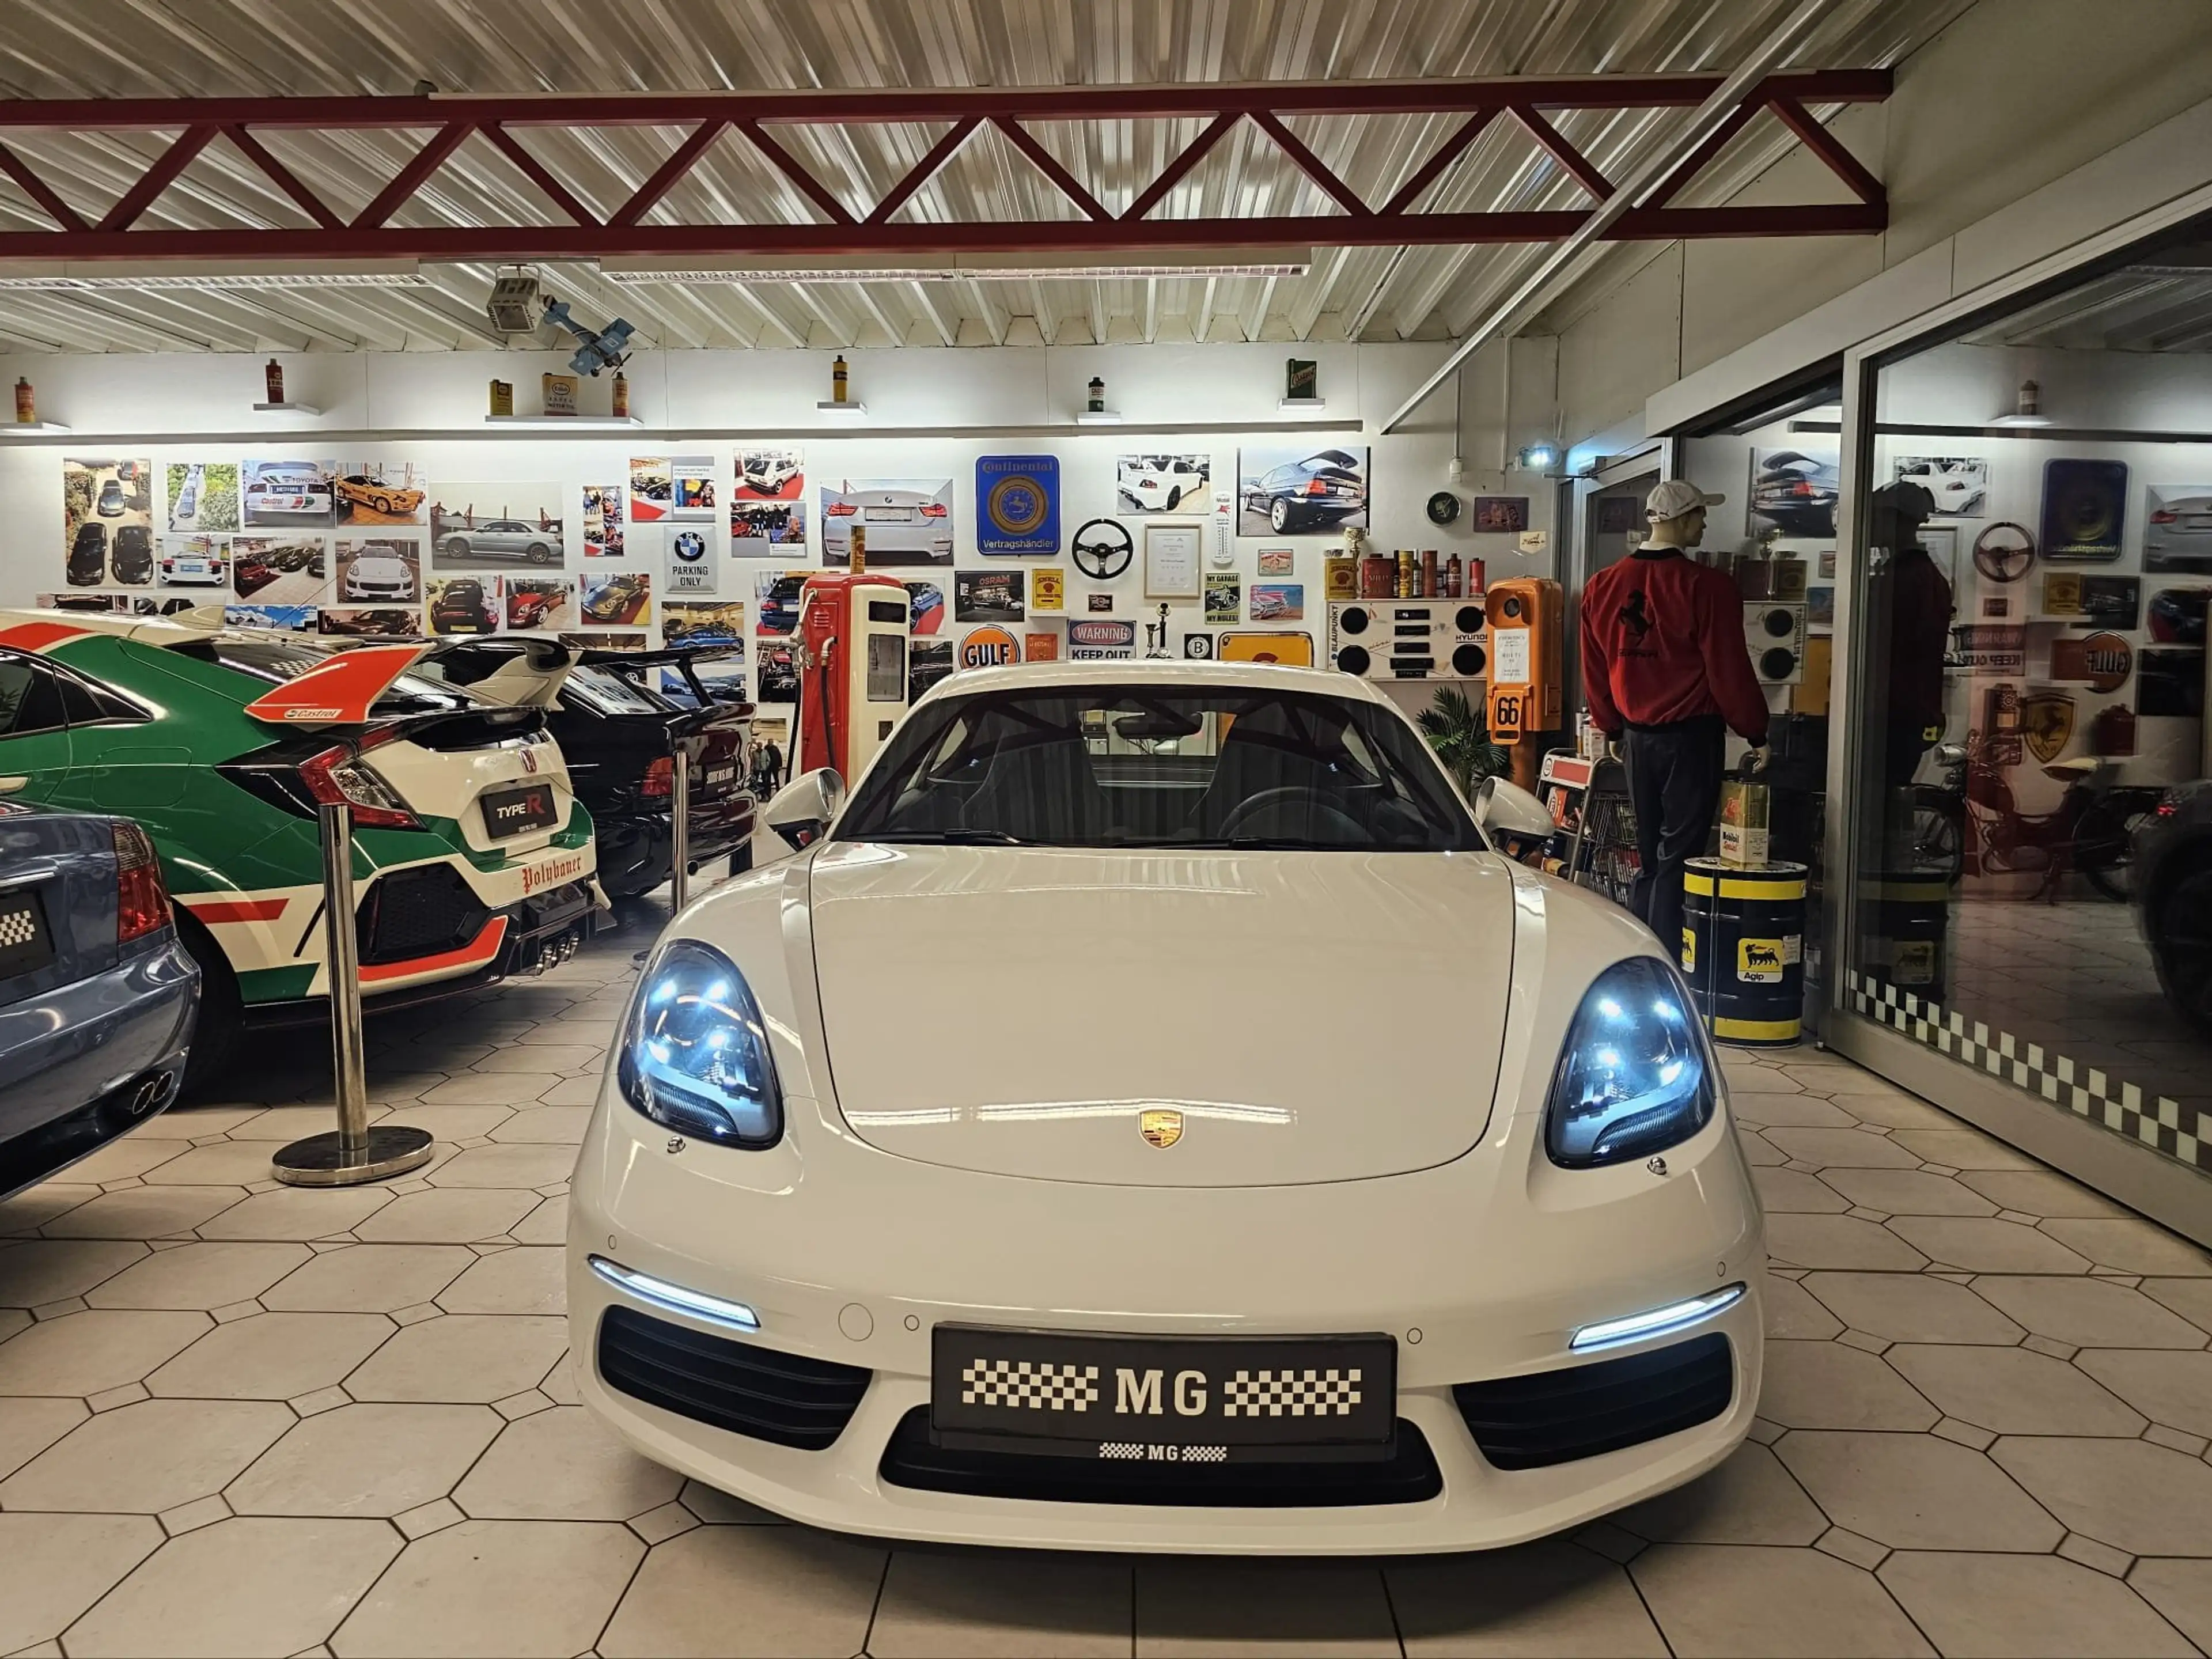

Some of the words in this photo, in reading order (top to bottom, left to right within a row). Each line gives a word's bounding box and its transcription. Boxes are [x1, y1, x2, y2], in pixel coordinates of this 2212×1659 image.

[982, 461, 1053, 474] Continental
[983, 539, 1054, 550] Vertragshändler
[672, 566, 709, 575] PARKING
[680, 577, 701, 586] ONLY
[979, 574, 1010, 585] OSRAM
[1077, 627, 1128, 640] WARNING
[1194, 641, 1203, 653] B
[964, 643, 1011, 667] GULF
[1072, 649, 1104, 660] KEEP
[1105, 650, 1131, 659] OUT
[297, 709, 338, 718] Castrol
[1497, 696, 1520, 725] 66
[496, 803, 527, 819] TYPE
[524, 793, 547, 815] R
[1744, 972, 1764, 981] Agip
[1147, 1444, 1178, 1461] MG
